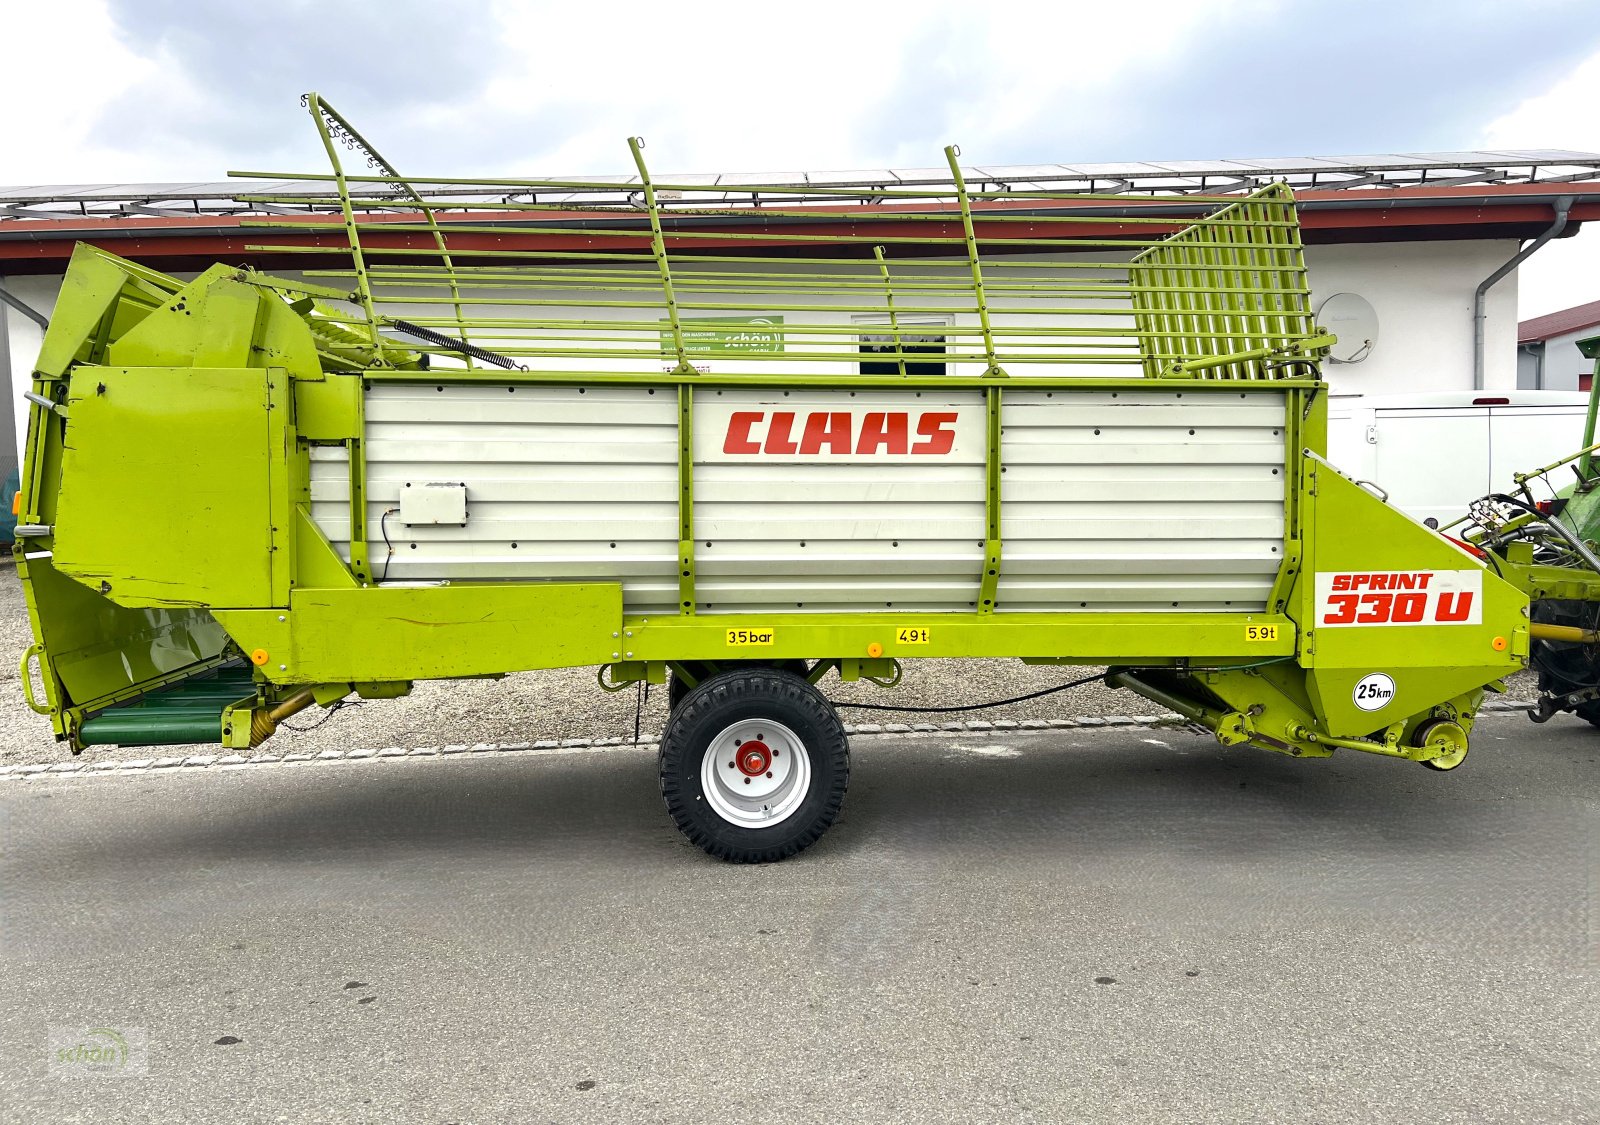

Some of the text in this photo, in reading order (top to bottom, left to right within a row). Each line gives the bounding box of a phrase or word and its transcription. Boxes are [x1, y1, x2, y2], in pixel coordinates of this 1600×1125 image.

[724, 332, 771, 347] schön
[723, 411, 959, 455] CLAAS
[1332, 574, 1434, 591] SPRINT
[1323, 591, 1474, 624] 330 U
[749, 630, 772, 643] bar
